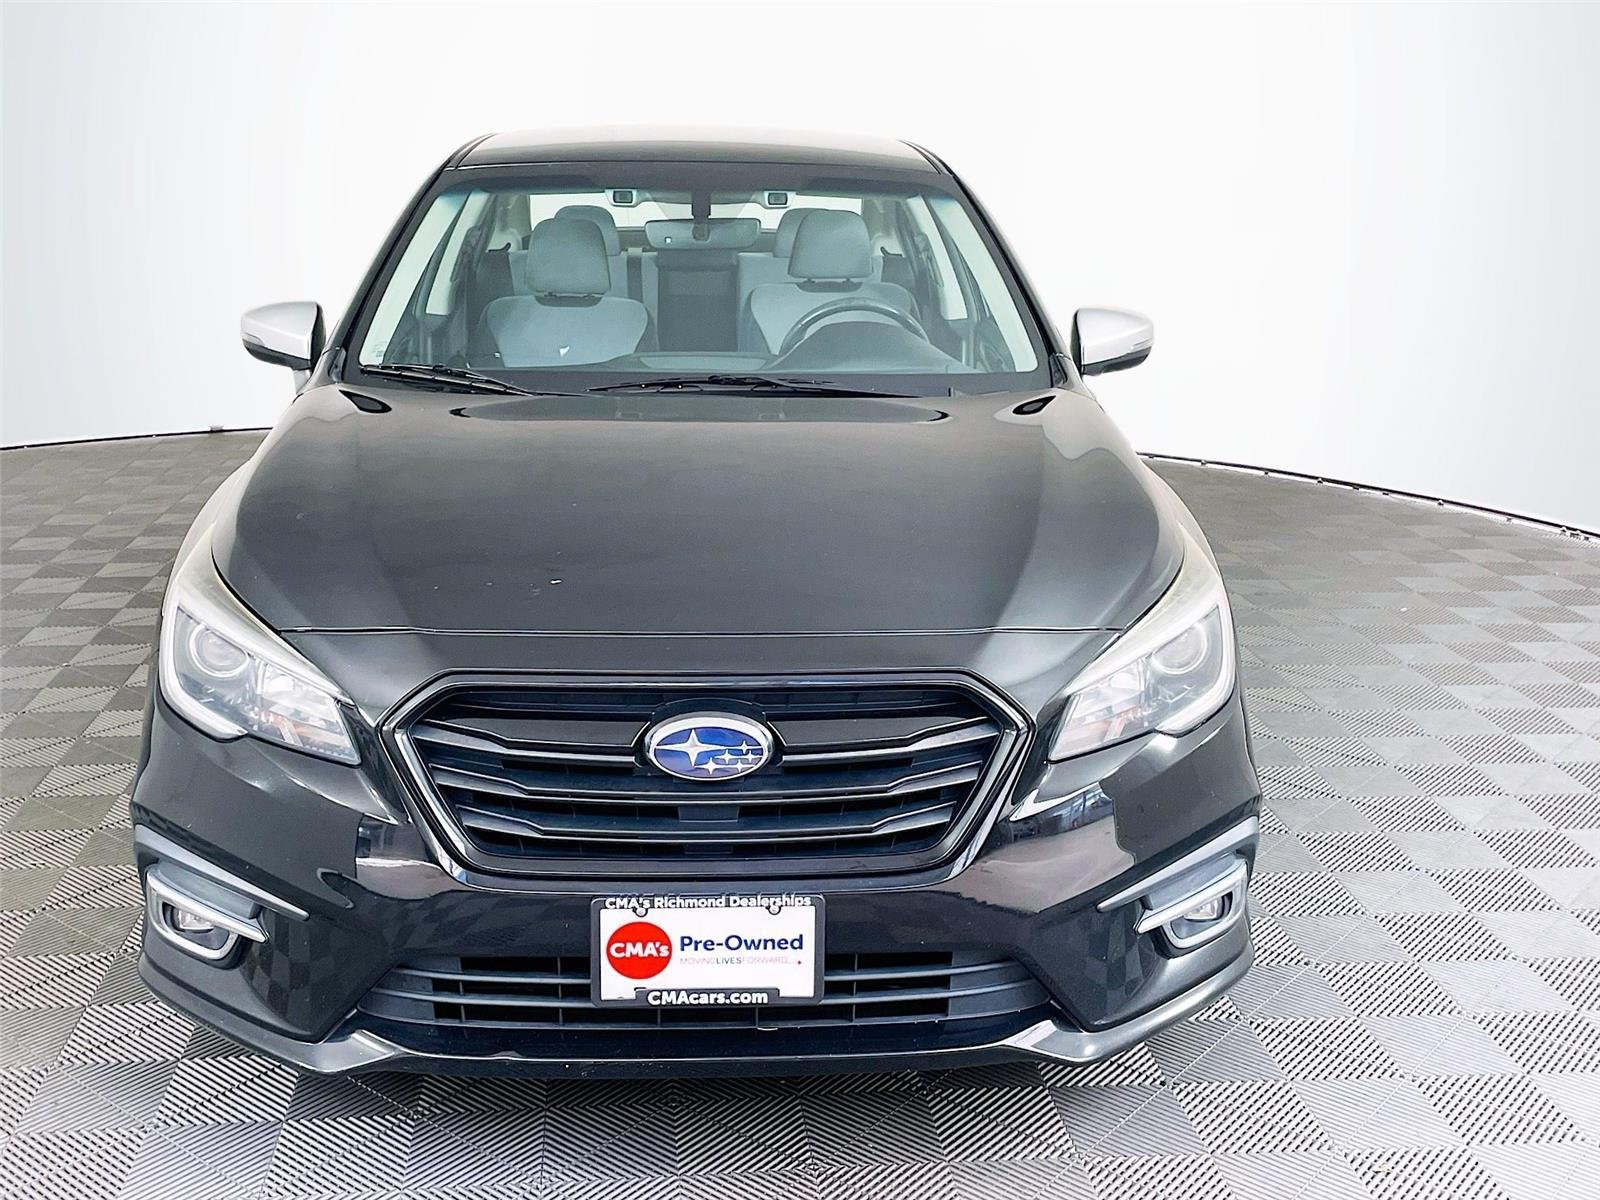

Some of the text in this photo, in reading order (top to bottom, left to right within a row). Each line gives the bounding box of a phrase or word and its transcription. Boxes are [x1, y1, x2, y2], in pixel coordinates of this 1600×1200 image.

[605, 895, 812, 909] CMA's Richmond Dealerships
[610, 942, 670, 958] CMA's
[680, 934, 803, 951] Pre-Owned
[647, 990, 768, 1006] CMAcars.com
